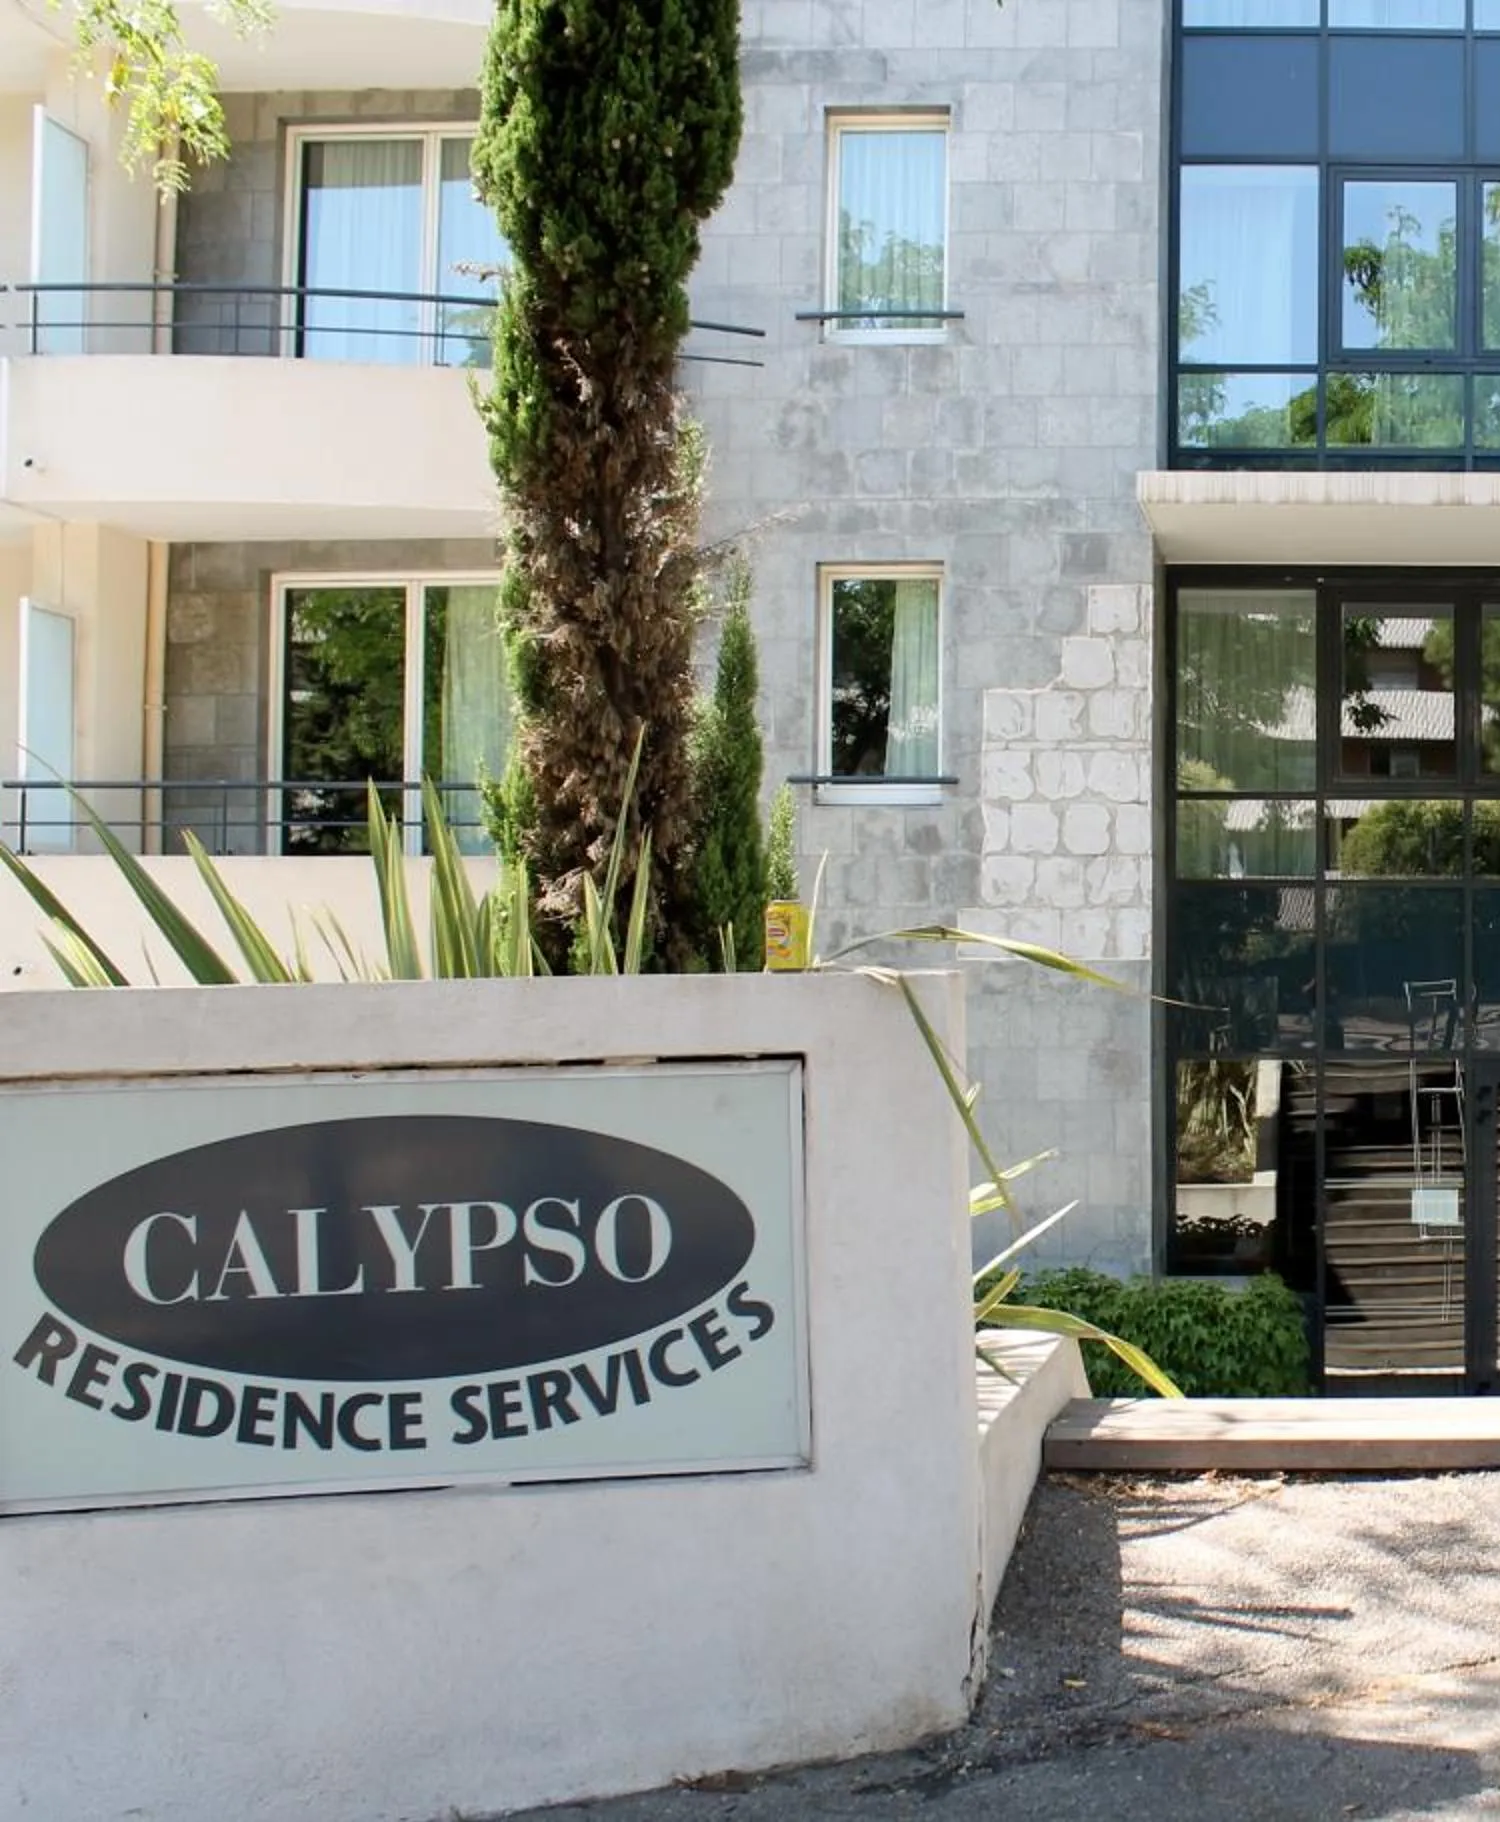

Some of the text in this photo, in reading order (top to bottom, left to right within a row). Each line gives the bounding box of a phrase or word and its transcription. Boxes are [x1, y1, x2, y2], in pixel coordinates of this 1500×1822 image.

[123, 1193, 673, 1306] CALYPSO
[12, 1281, 775, 1452] RESIDENCE SERVICES
